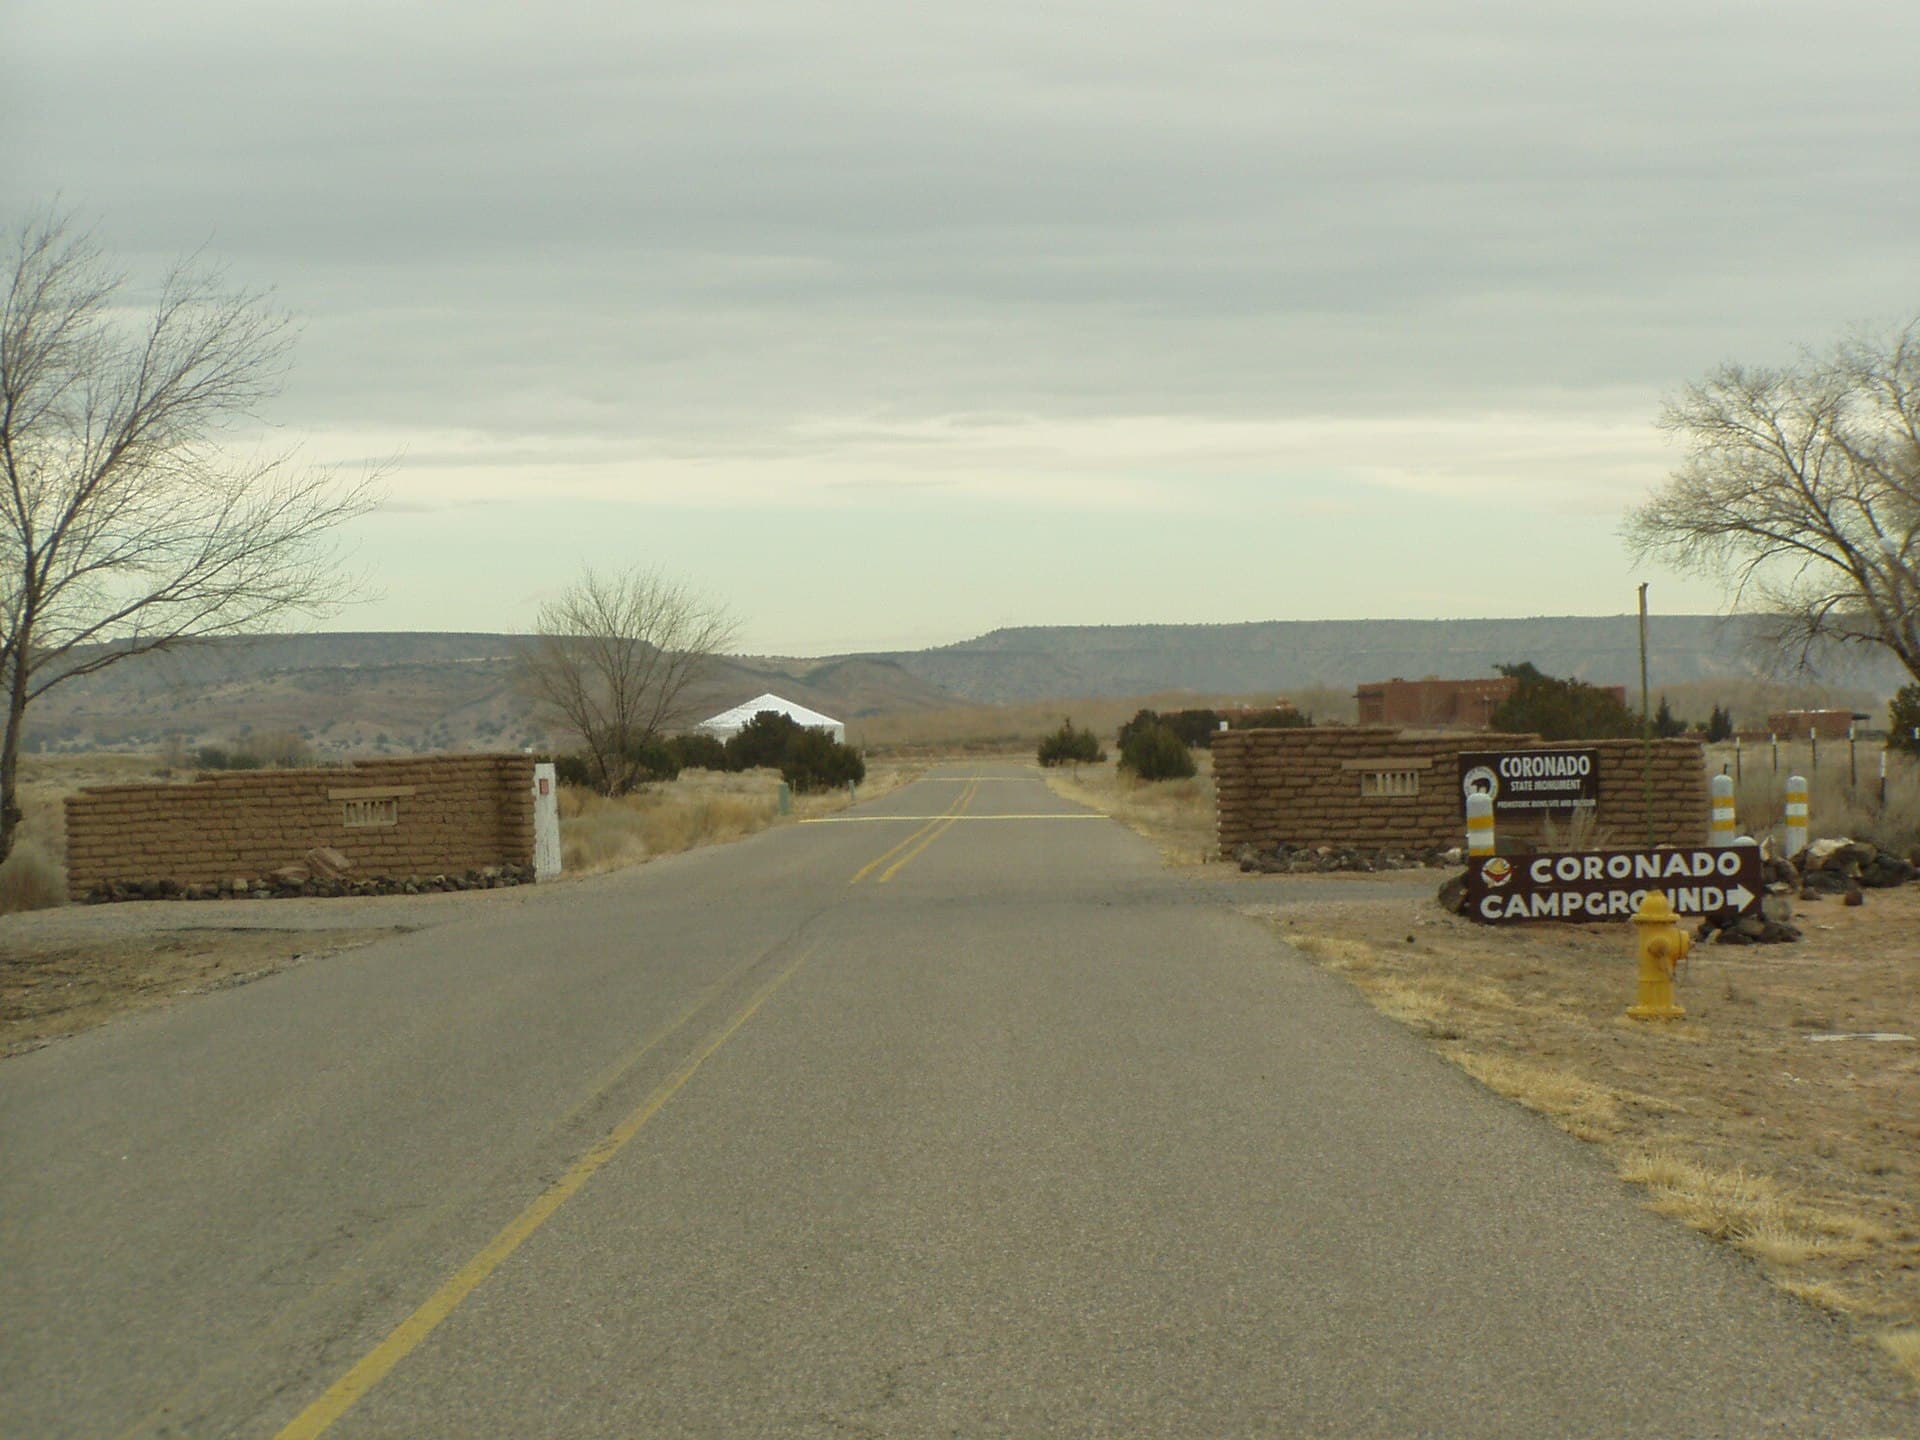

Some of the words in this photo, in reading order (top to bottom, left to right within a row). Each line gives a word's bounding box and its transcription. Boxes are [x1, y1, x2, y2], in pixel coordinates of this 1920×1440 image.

[1500, 756, 1590, 777] CORONADO
[1511, 780, 1533, 792] STATE
[1534, 779, 1582, 791] MONUMENT
[1530, 852, 1741, 883] CORONADO
